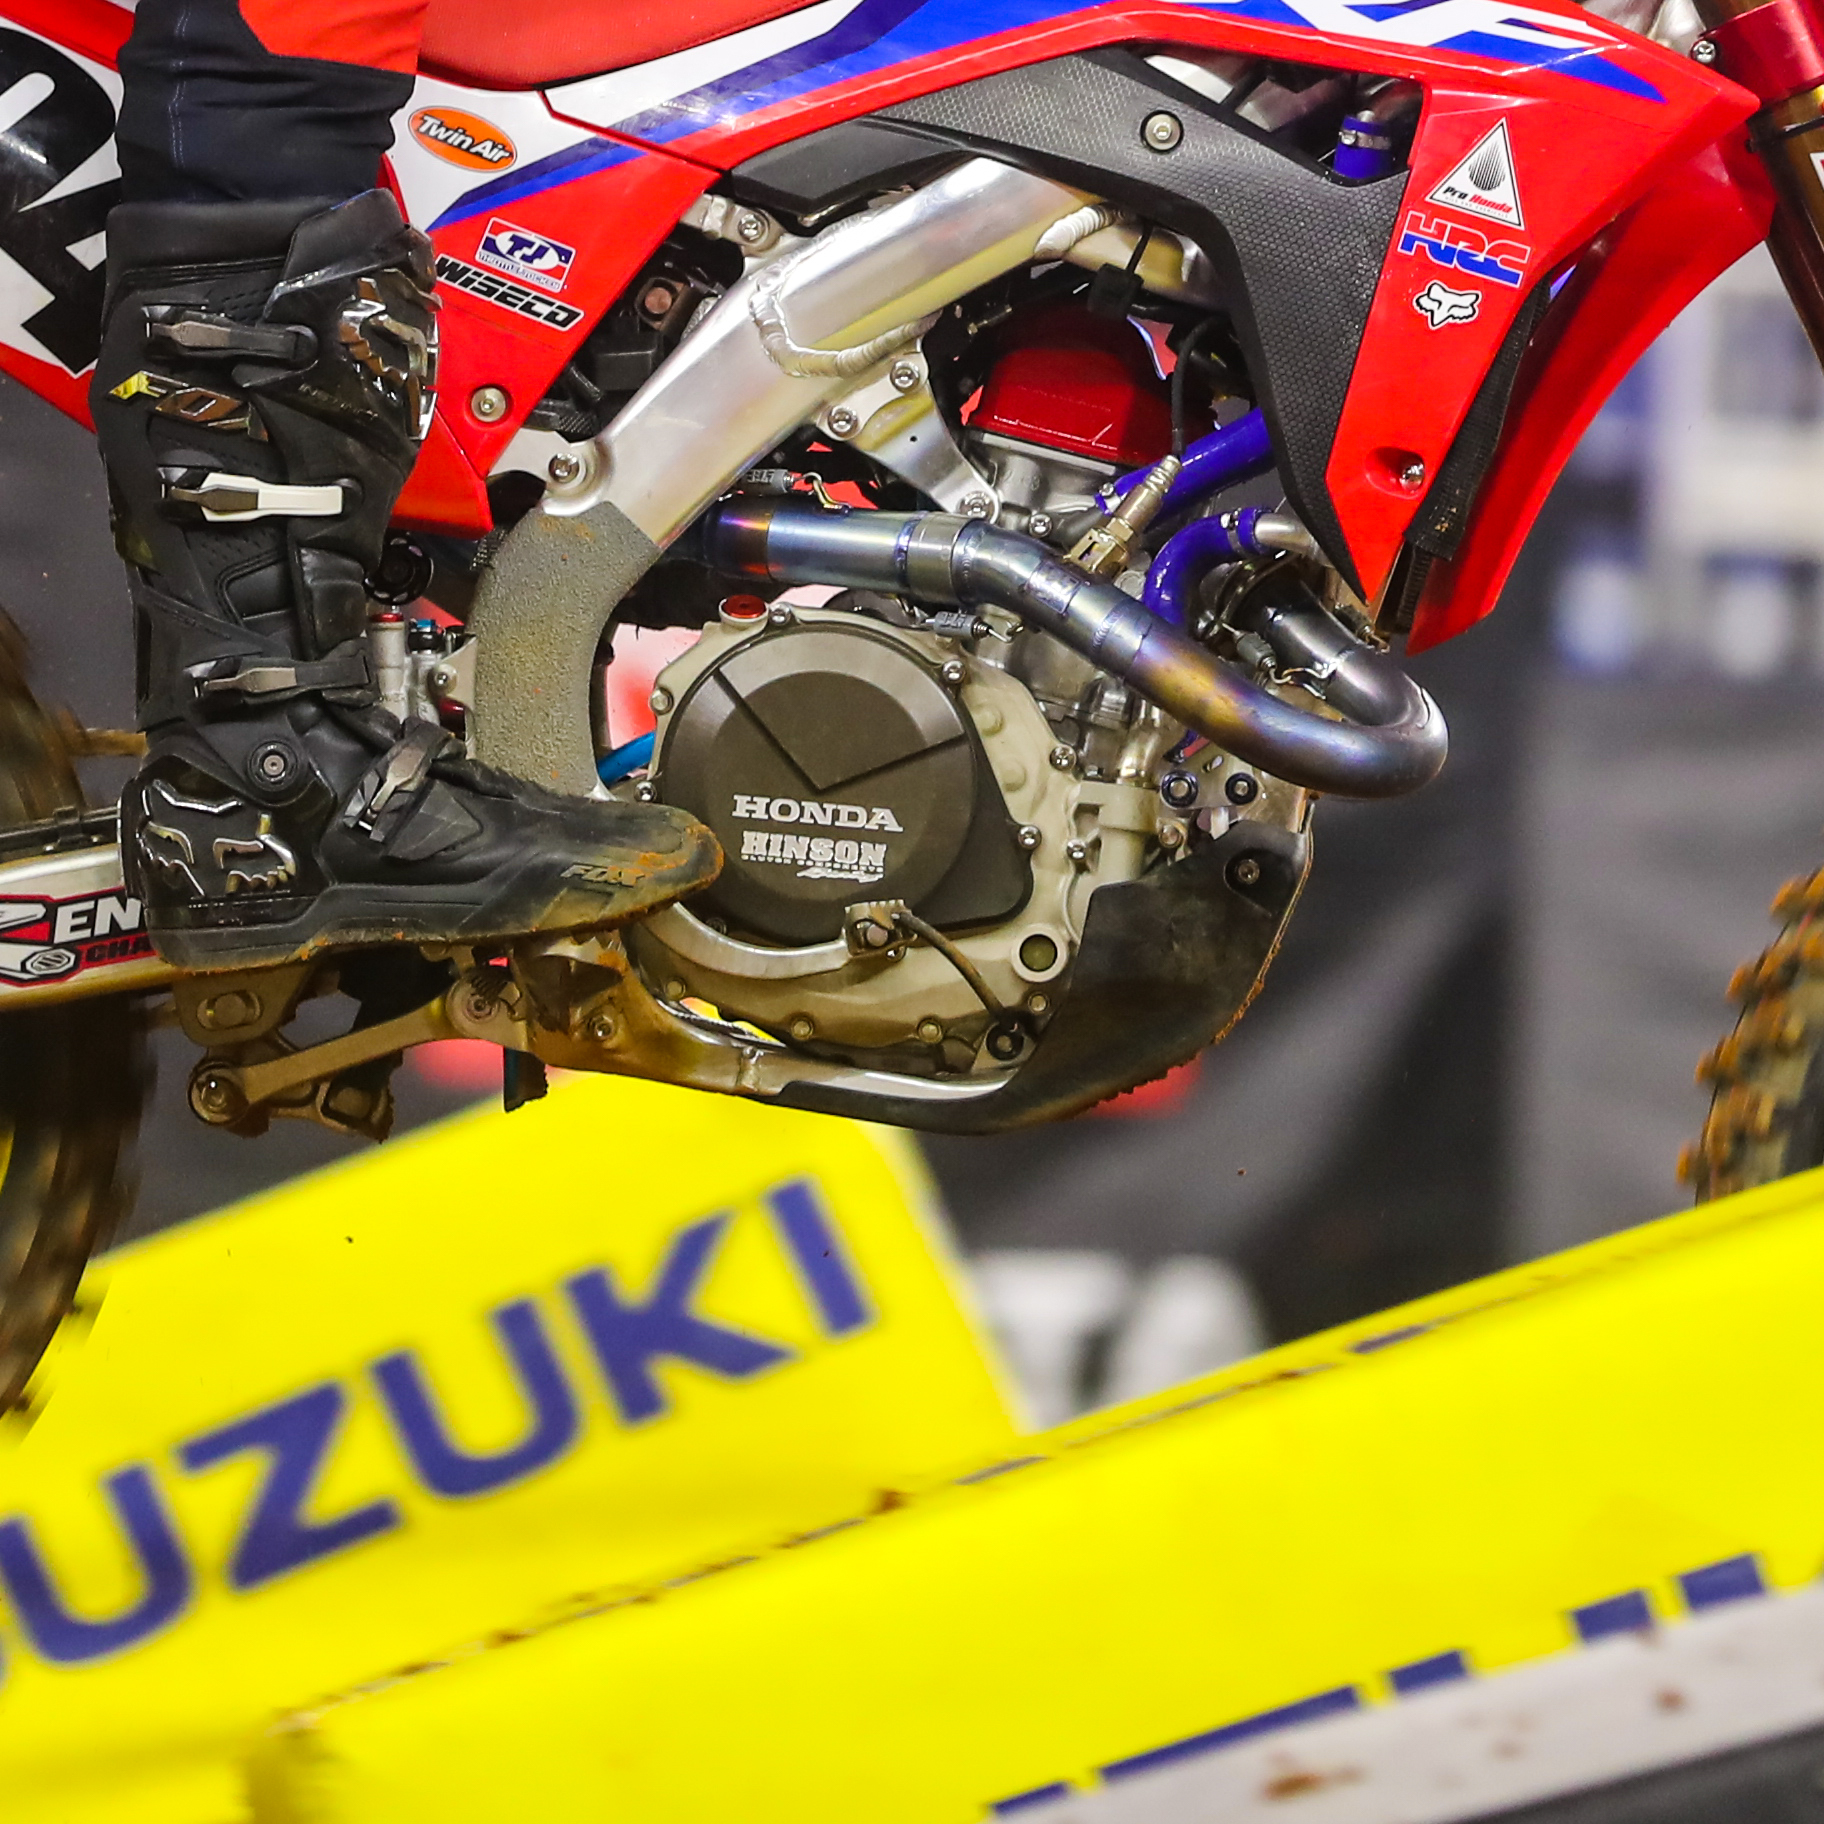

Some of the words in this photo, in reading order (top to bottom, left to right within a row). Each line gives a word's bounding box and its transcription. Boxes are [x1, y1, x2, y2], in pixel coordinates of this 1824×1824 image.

[417, 114, 470, 151] Twin
[469, 138, 511, 164] Air
[1443, 186, 1468, 199] Pro
[1468, 194, 1514, 214] Honda
[504, 233, 551, 265] TJ
[1397, 210, 1531, 289] HRC
[732, 794, 904, 833] HONDA
[741, 830, 887, 867] HINSON
